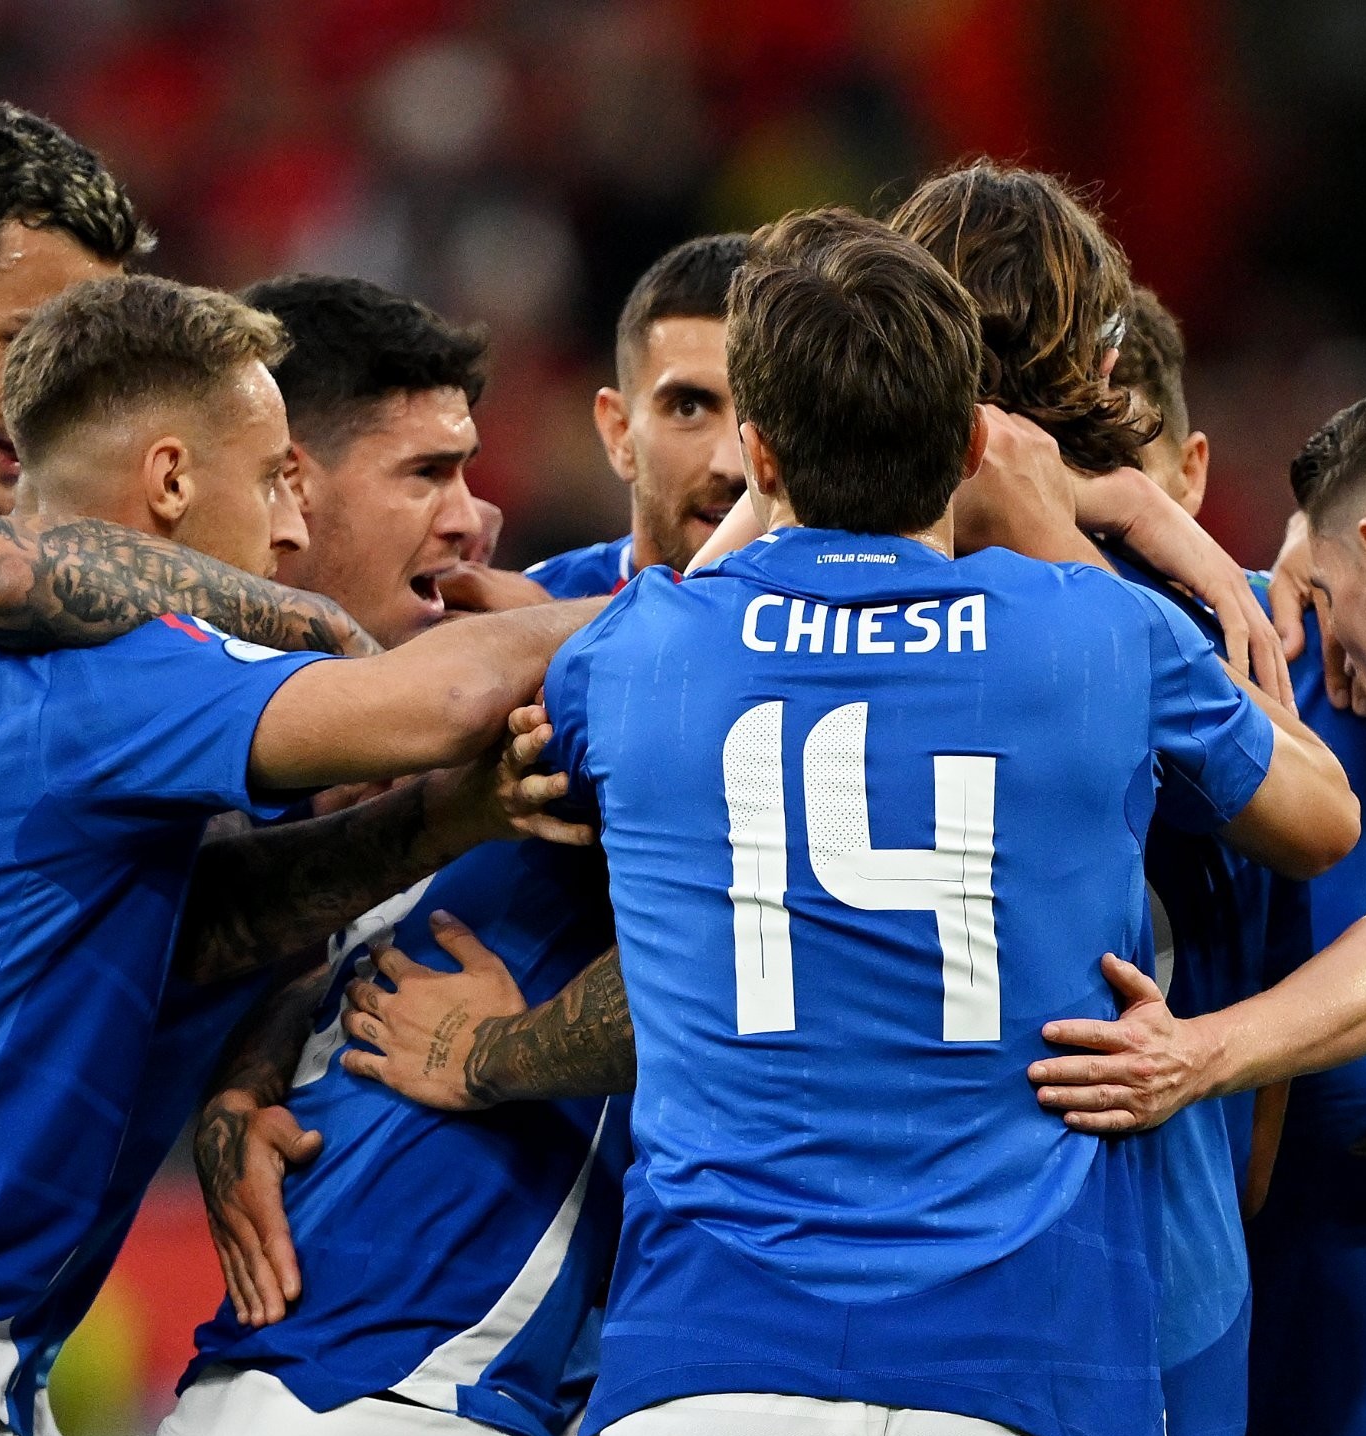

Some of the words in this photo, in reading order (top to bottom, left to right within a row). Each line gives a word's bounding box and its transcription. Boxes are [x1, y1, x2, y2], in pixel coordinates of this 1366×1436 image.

[816, 553, 855, 564] L'ITALIA
[742, 594, 987, 654] CHIESA
[722, 701, 1001, 1042] 14
